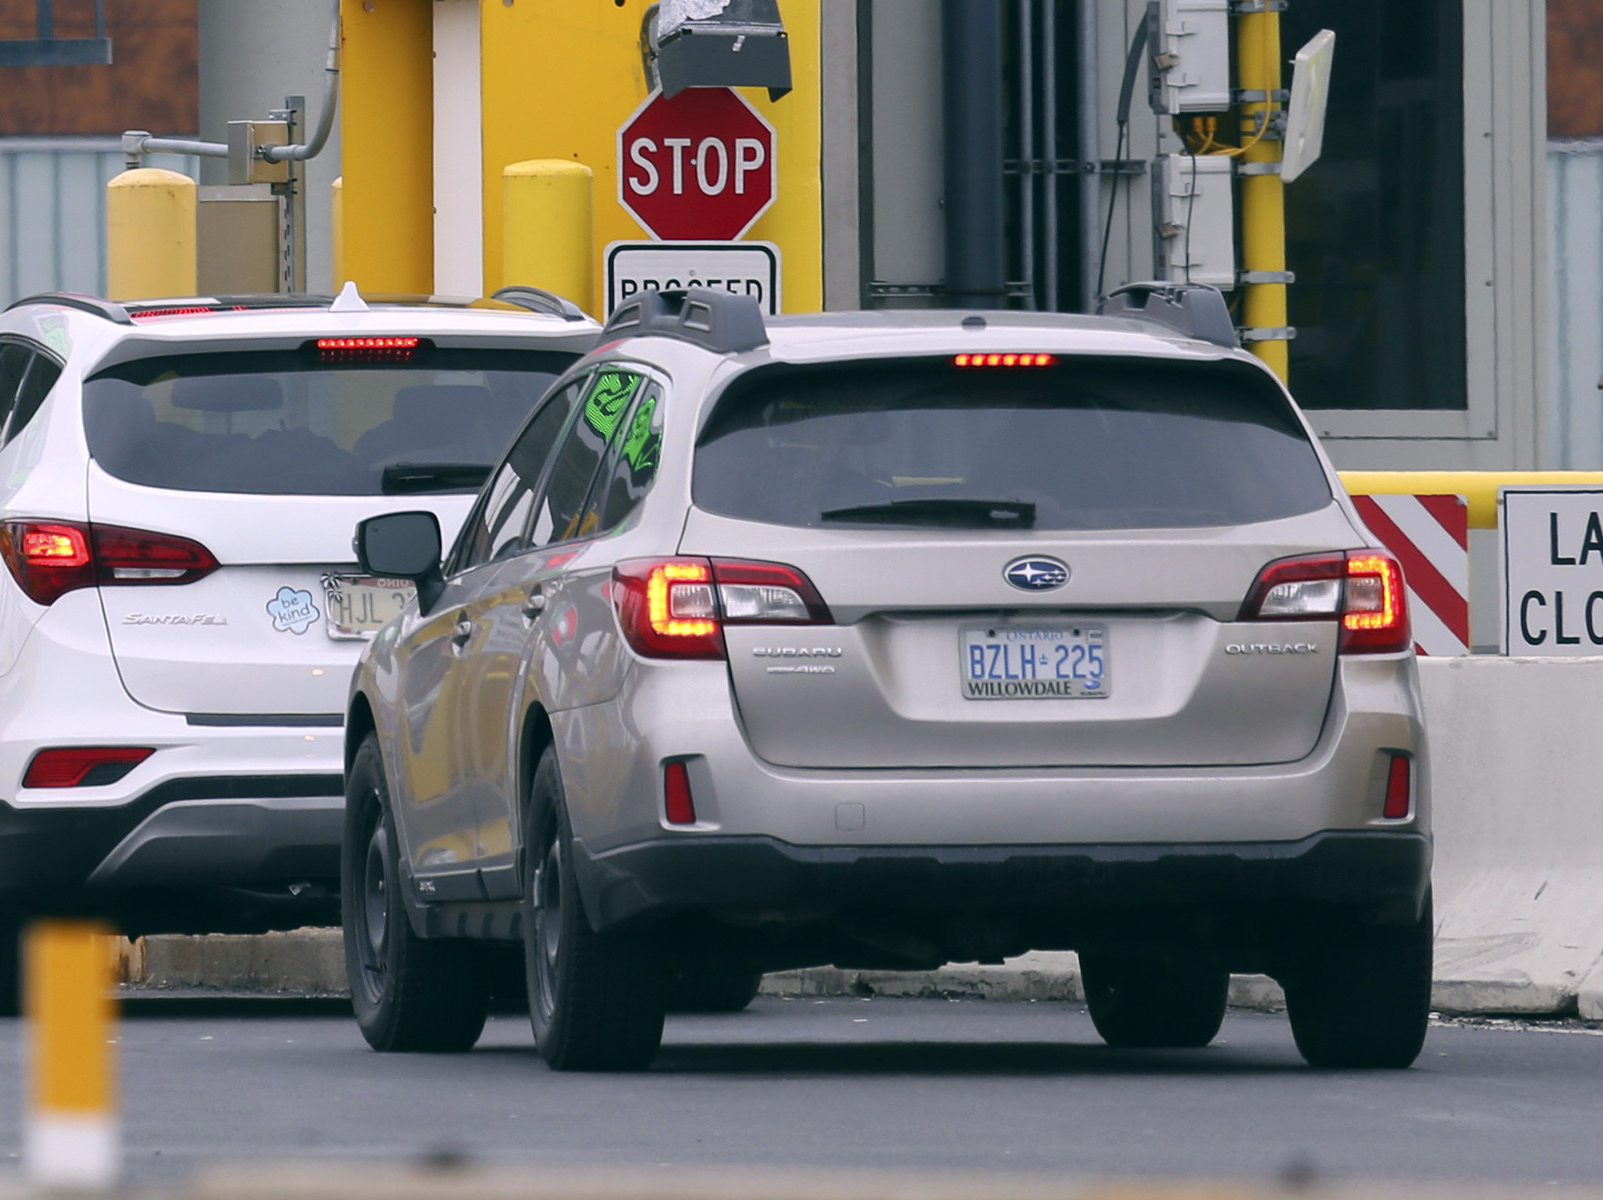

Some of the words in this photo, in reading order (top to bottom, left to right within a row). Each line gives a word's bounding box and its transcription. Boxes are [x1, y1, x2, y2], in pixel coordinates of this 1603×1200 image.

[628, 137, 766, 196] STOP
[1550, 511, 1603, 565] LA
[378, 579, 410, 588] OHIO
[280, 597, 299, 609] be
[278, 602, 311, 623] kind
[752, 647, 842, 658] SUBARU
[1225, 643, 1319, 655] OUTBACK
[969, 644, 1036, 679] BZLH
[1054, 644, 1104, 679] 225
[968, 681, 1072, 696] WILLOWDALE
